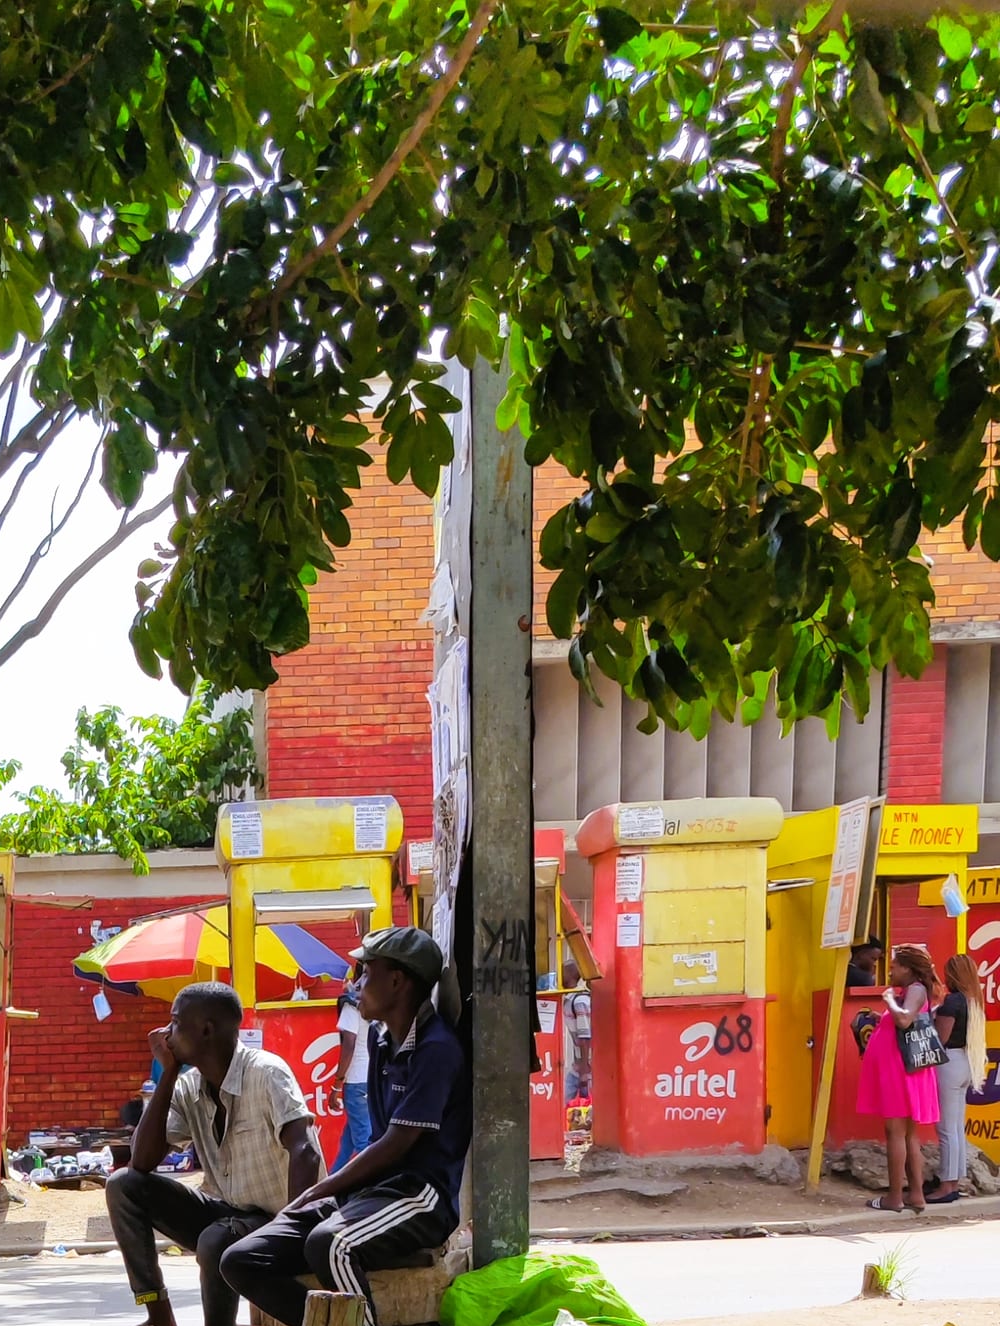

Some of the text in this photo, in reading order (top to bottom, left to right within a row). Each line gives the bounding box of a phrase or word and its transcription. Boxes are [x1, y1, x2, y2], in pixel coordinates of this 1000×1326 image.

[893, 812, 918, 823] MTN
[663, 818, 681, 836] ial
[909, 827, 964, 846] MONEY
[713, 1014, 753, 1056] 68
[918, 1040, 932, 1052] MY
[913, 1050, 942, 1068] HEART
[654, 1065, 737, 1098] airtel
[664, 1107, 727, 1124] money
